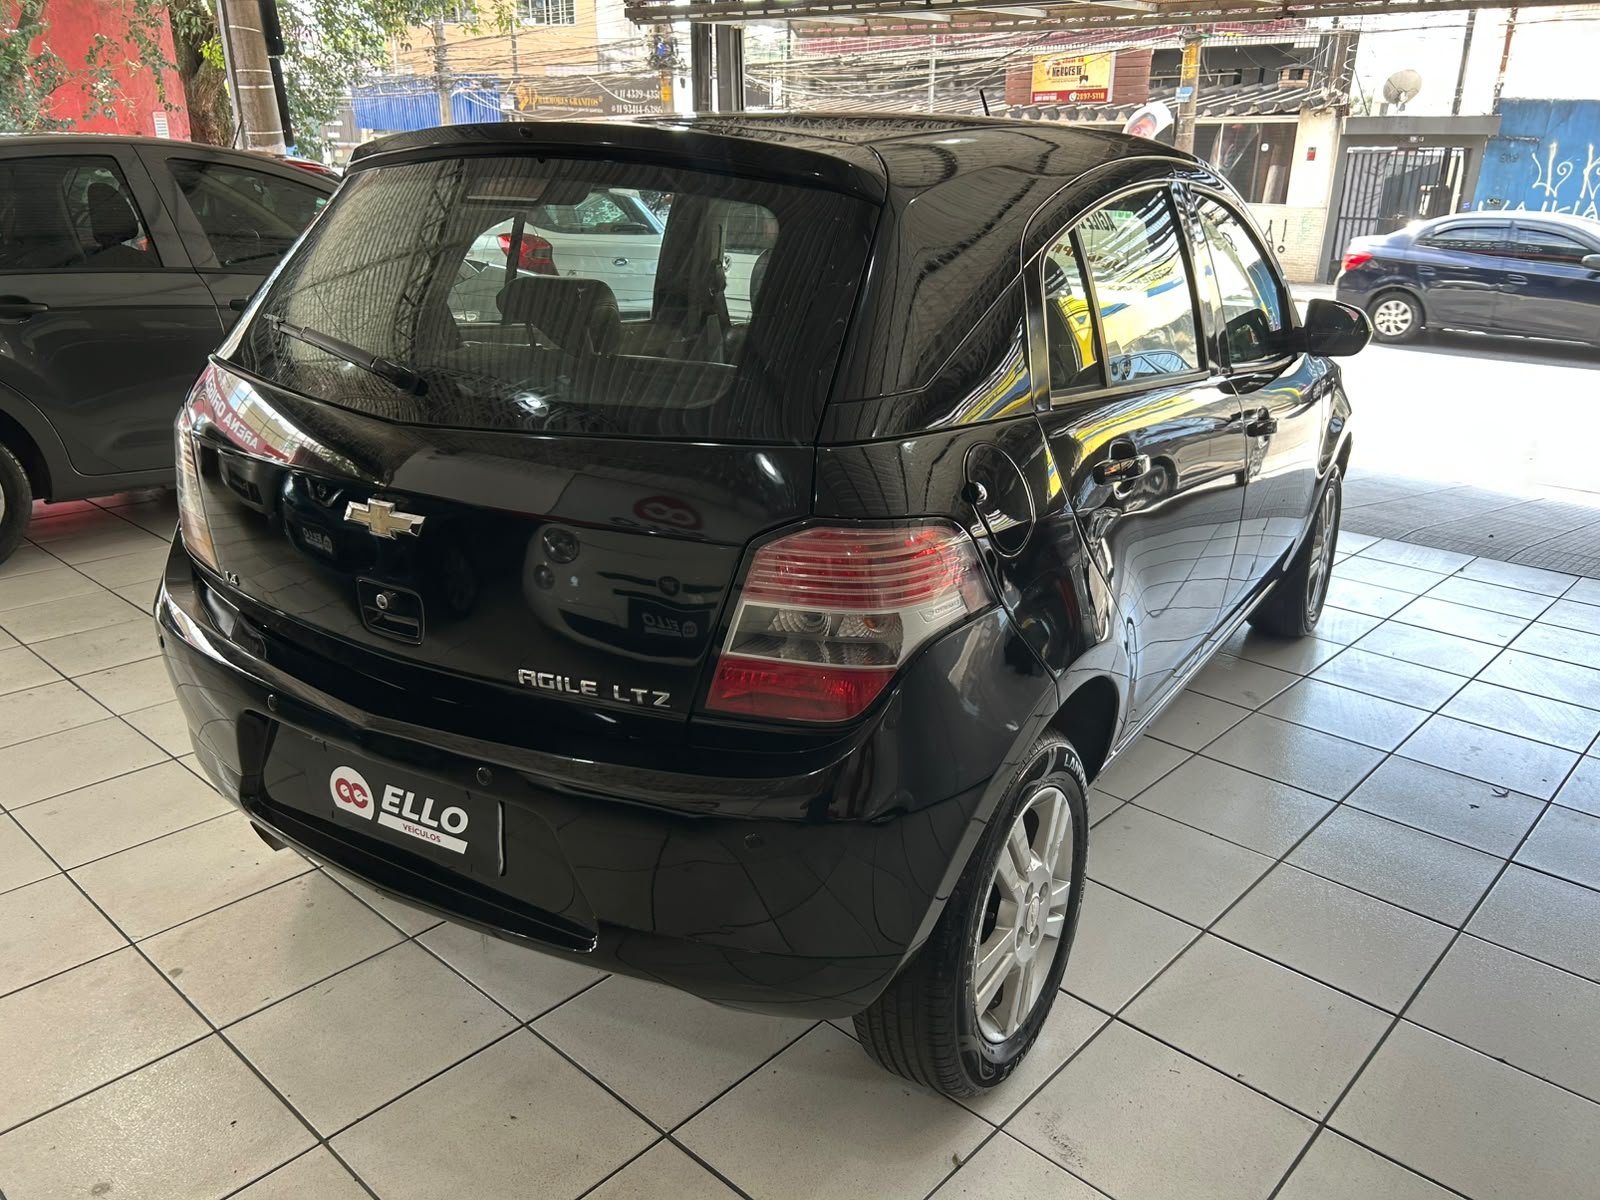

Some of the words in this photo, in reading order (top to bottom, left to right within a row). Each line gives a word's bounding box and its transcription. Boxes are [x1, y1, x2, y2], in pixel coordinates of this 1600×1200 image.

[569, 96, 599, 107] GRANITOS
[518, 668, 599, 697] AGILE
[613, 684, 671, 708] LTZ
[381, 784, 469, 835] ELLO
